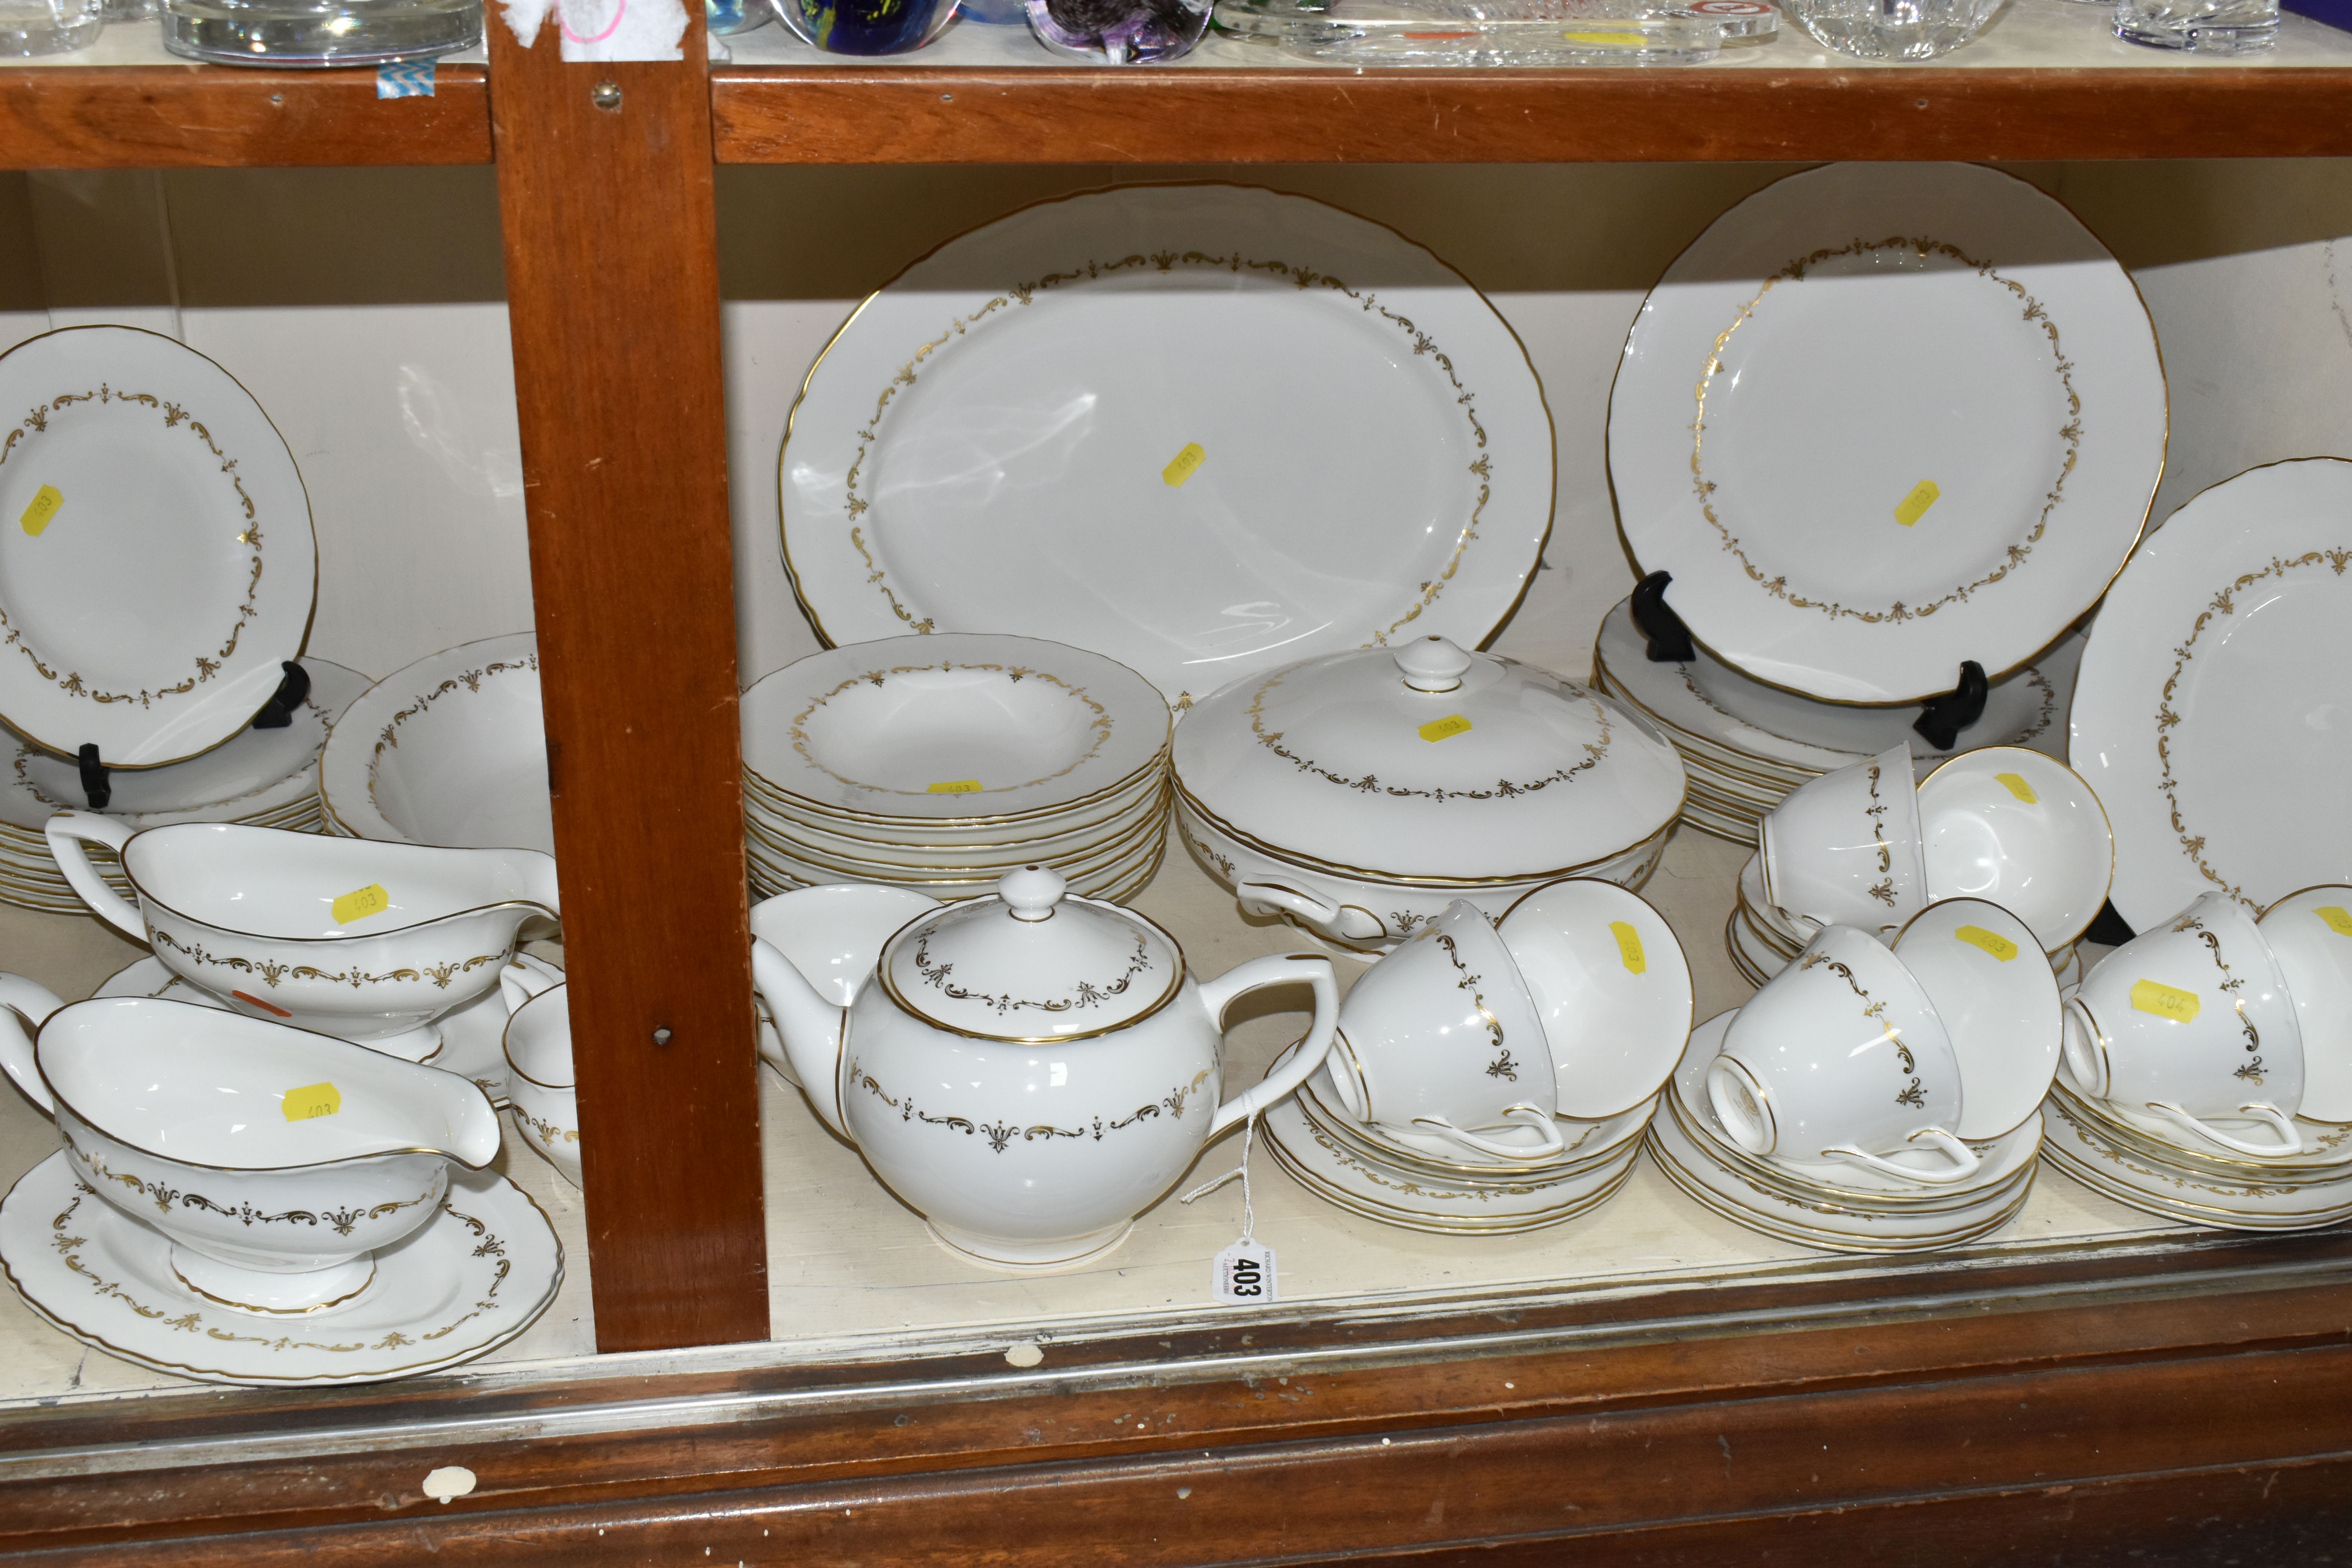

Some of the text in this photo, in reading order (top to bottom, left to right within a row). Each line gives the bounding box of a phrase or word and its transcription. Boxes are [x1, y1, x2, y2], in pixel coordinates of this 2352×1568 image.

[1178, 452, 1196, 470] 403
[34, 495, 52, 516] 403
[1438, 720, 1460, 732] 403
[355, 893, 376, 911] 403
[1981, 936, 2006, 952] 403
[1232, 1259, 1261, 1296] 403
